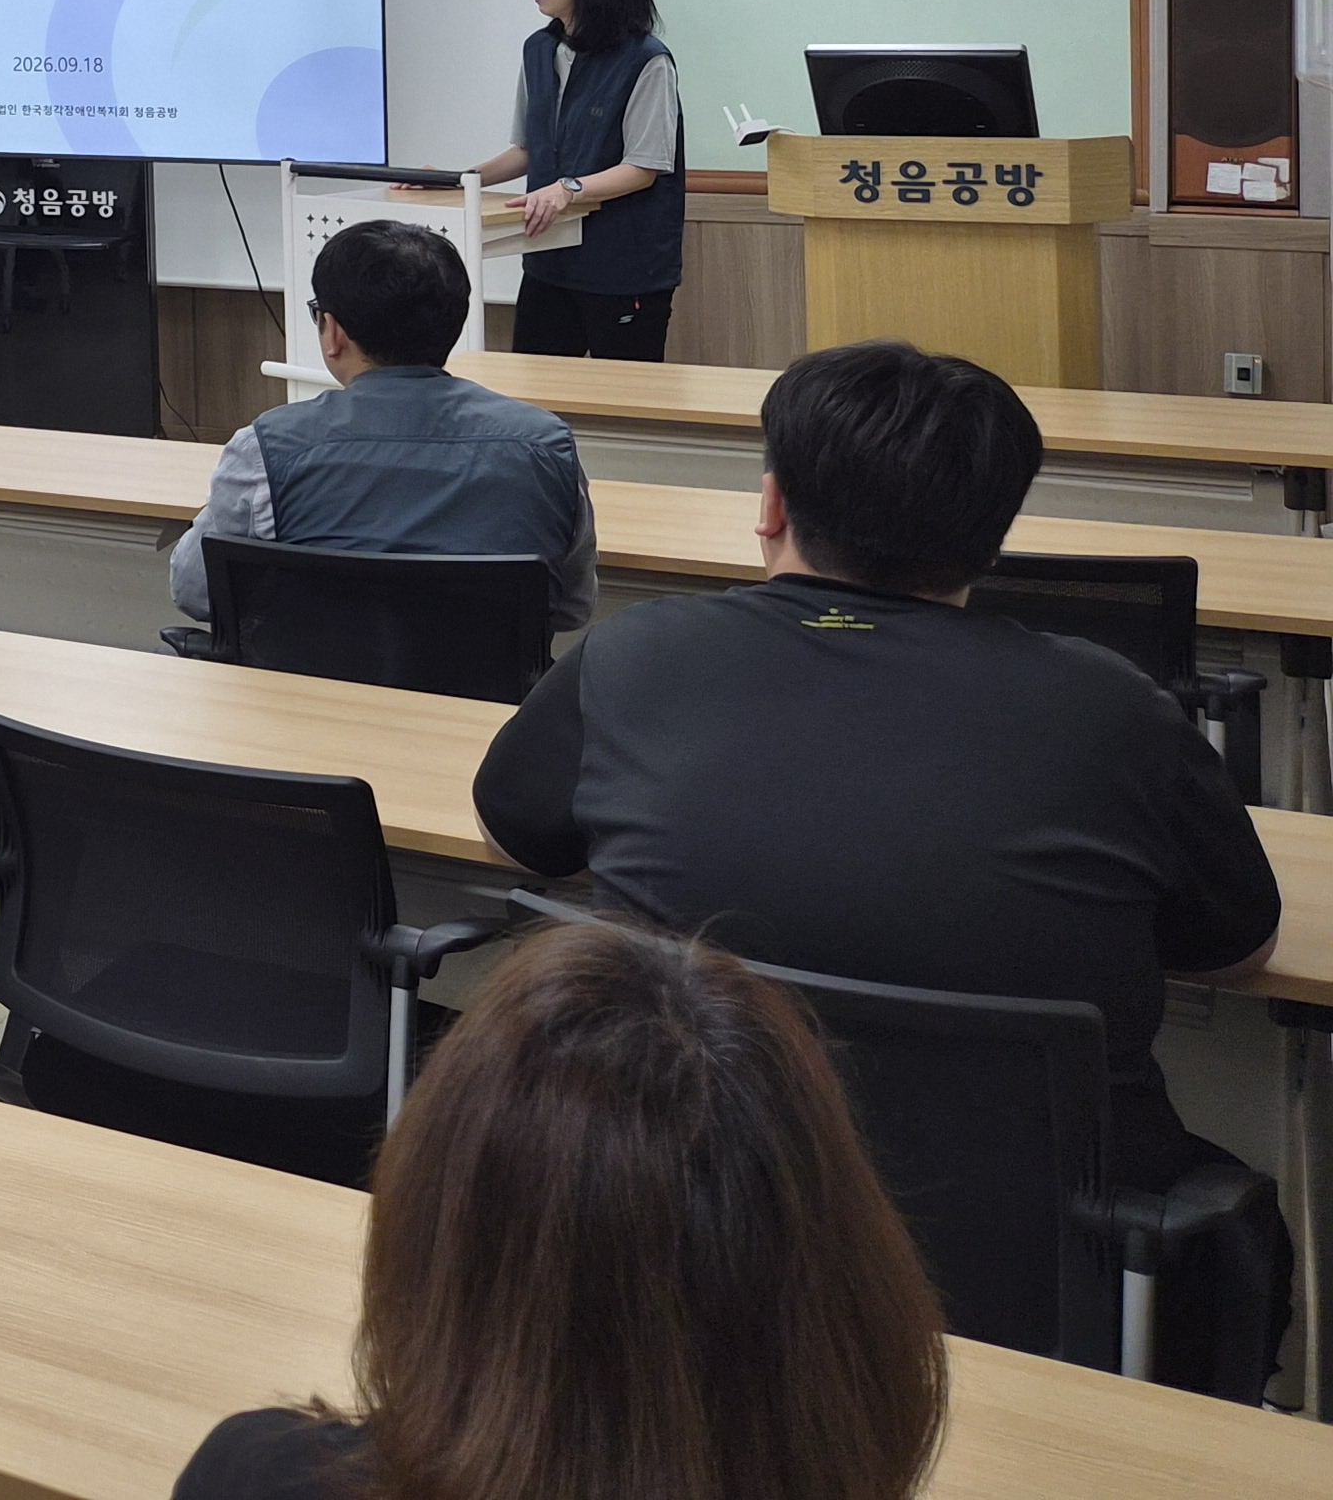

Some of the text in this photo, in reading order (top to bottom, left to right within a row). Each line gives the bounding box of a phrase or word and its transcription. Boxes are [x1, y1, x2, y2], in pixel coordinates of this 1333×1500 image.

[13, 56, 104, 73] 2026.09.18
[22, 104, 129, 117] 한국청각장애인복지회
[134, 106, 178, 118] 청음공방
[839, 160, 1044, 206] 청음공방
[12, 187, 118, 218] 청음공방
